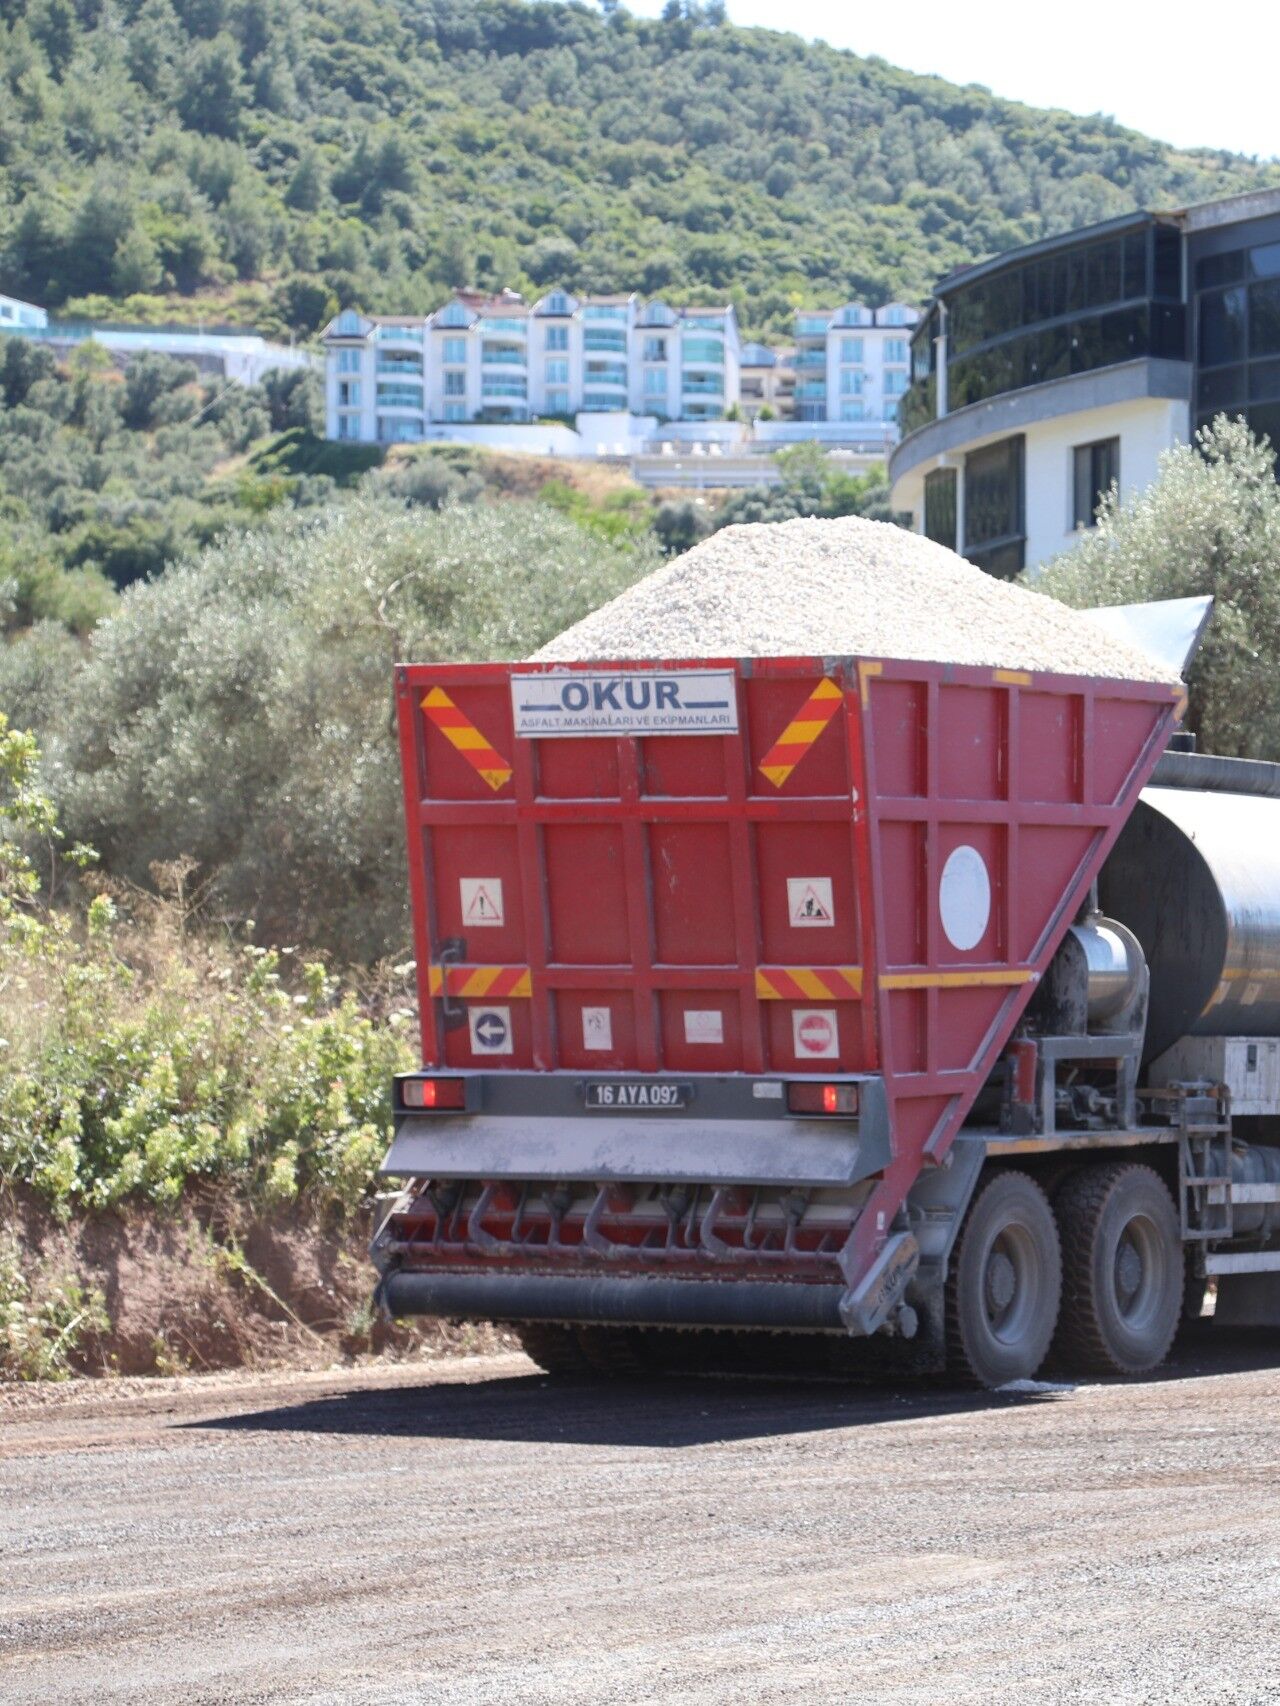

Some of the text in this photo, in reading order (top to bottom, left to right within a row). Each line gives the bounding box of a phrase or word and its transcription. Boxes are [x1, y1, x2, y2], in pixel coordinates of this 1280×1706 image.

[561, 681, 682, 711] OKUR
[520, 717, 560, 728] ASFALT
[636, 715, 650, 726] VE
[653, 714, 730, 726] EKİPMANLARI
[597, 1086, 678, 1104] 16 AYA 097
